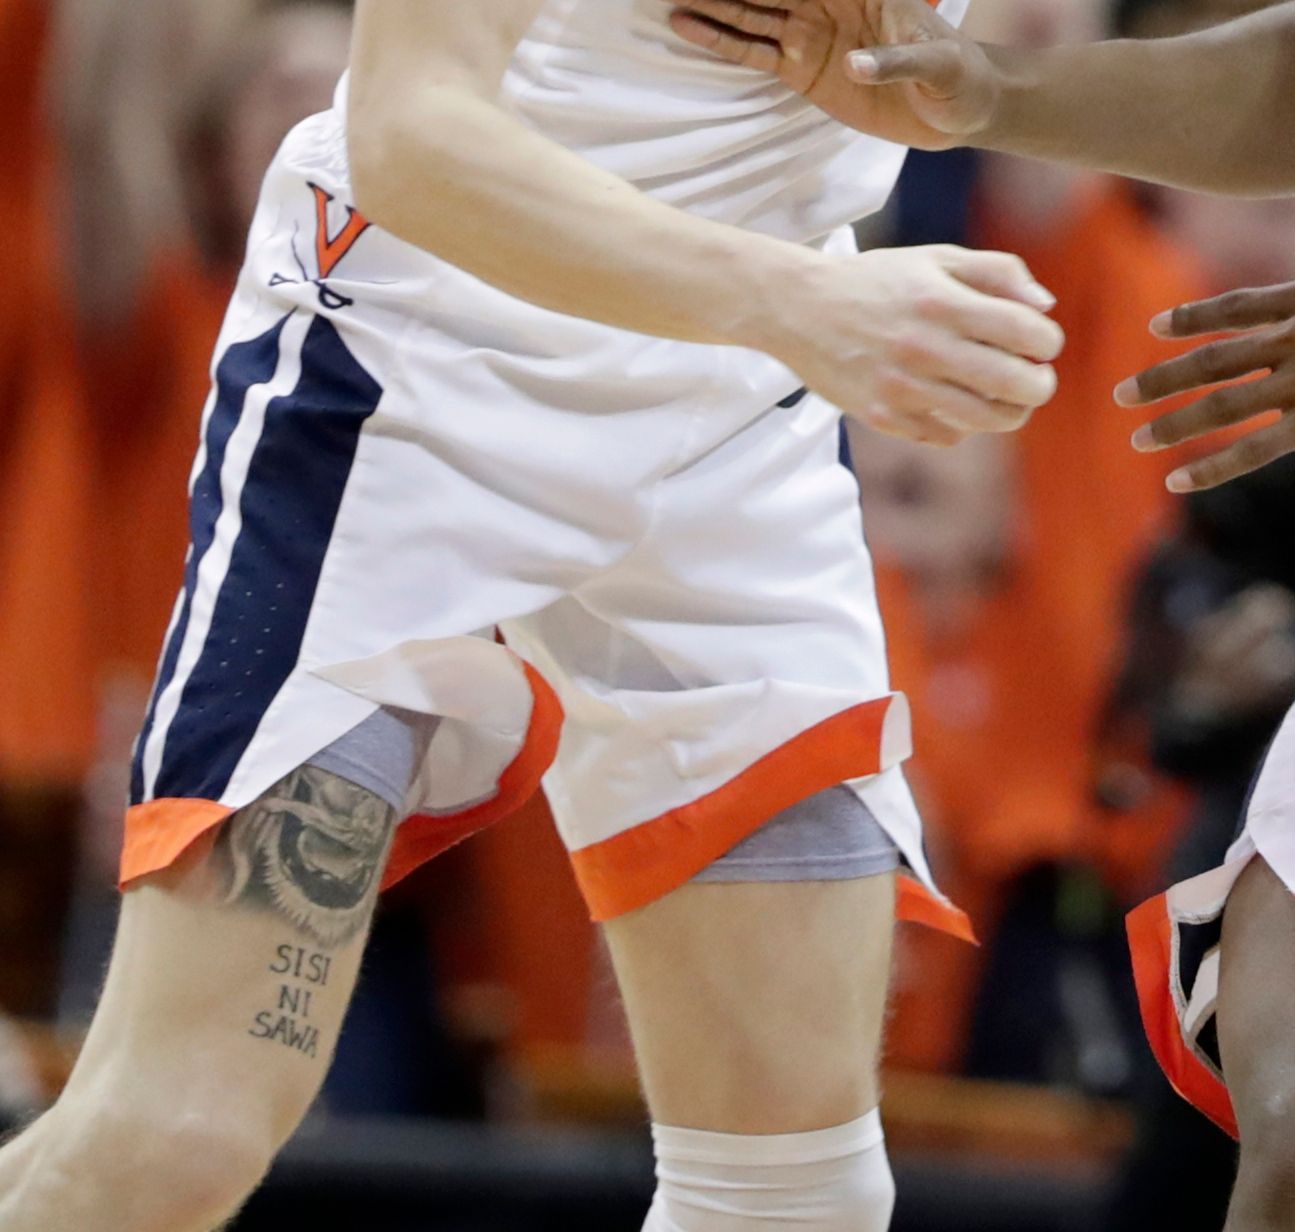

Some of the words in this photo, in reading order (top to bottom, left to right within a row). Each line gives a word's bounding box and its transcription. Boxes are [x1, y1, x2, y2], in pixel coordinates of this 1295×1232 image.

[269, 944, 332, 986] SISI
[279, 985, 311, 1017] NI
[248, 1012, 319, 1058] SAWA
